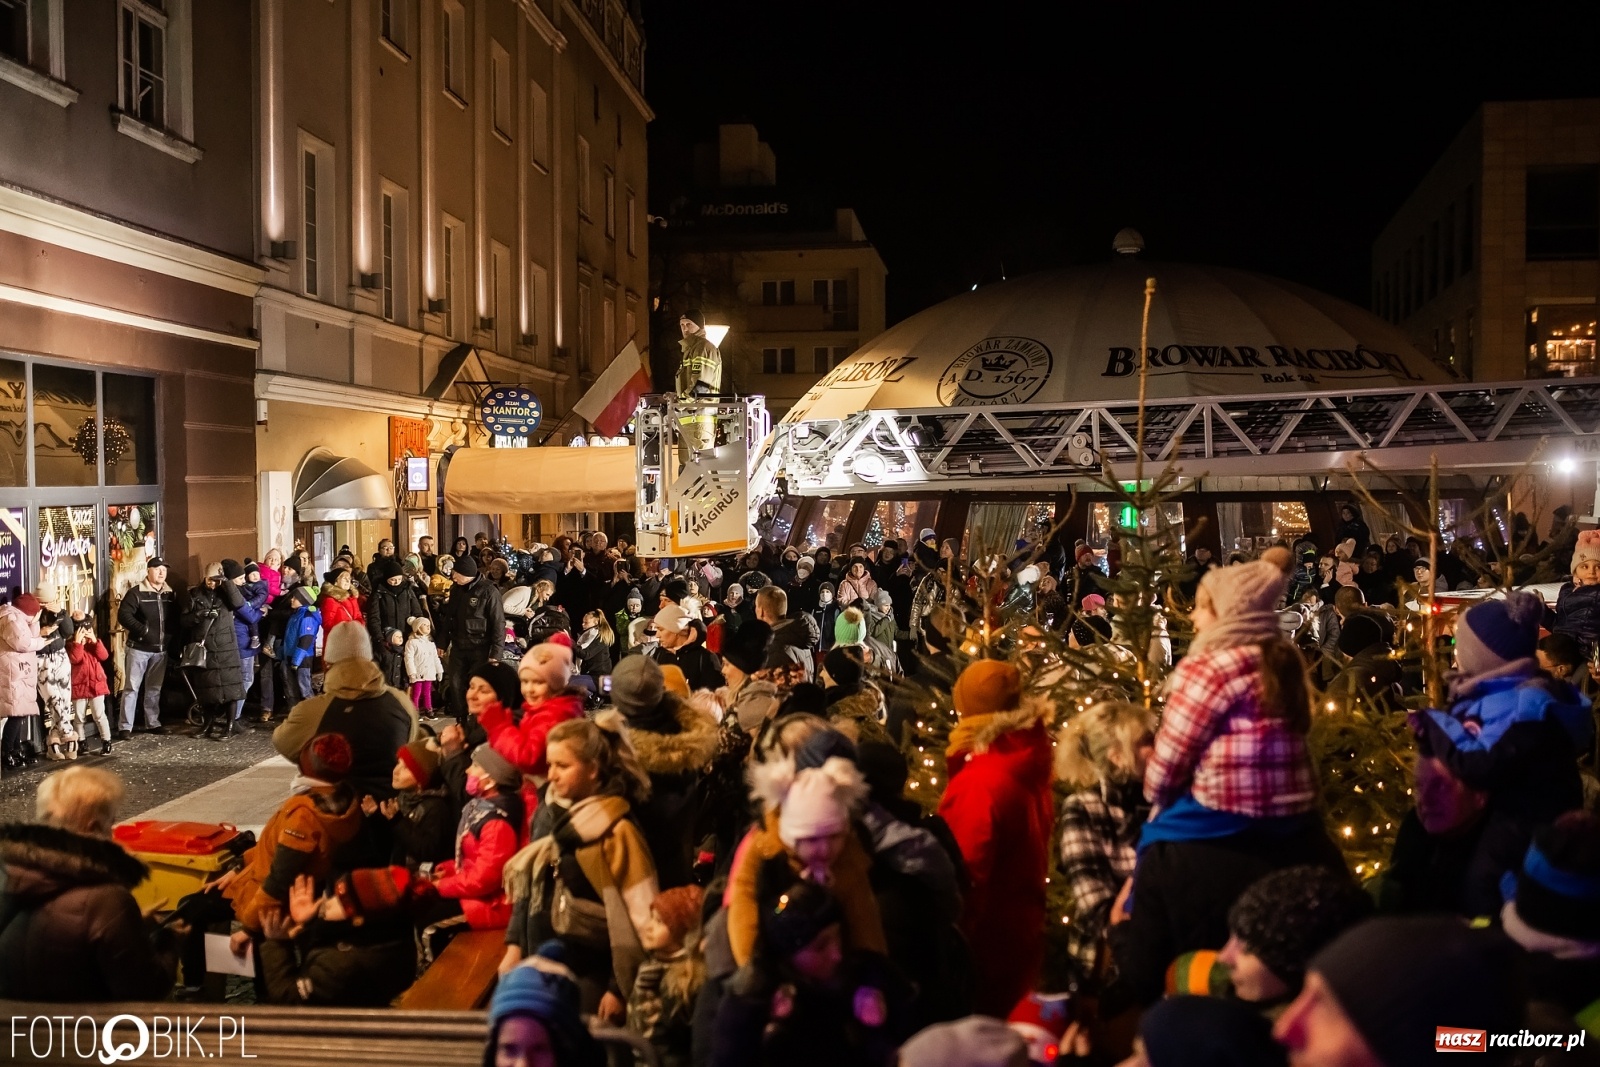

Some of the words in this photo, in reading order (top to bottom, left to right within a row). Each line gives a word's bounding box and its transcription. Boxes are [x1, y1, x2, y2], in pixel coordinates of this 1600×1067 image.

[701, 202, 789, 216] McDonald's
[953, 340, 1001, 368] BROWAR
[1004, 339, 1048, 368] ZAMKOWY
[1101, 344, 1268, 377] BROWAR
[992, 368, 1040, 391] 1567
[1260, 372, 1297, 384] Rok
[492, 405, 531, 417] KANTOR
[692, 488, 739, 537] MAGIRUS
